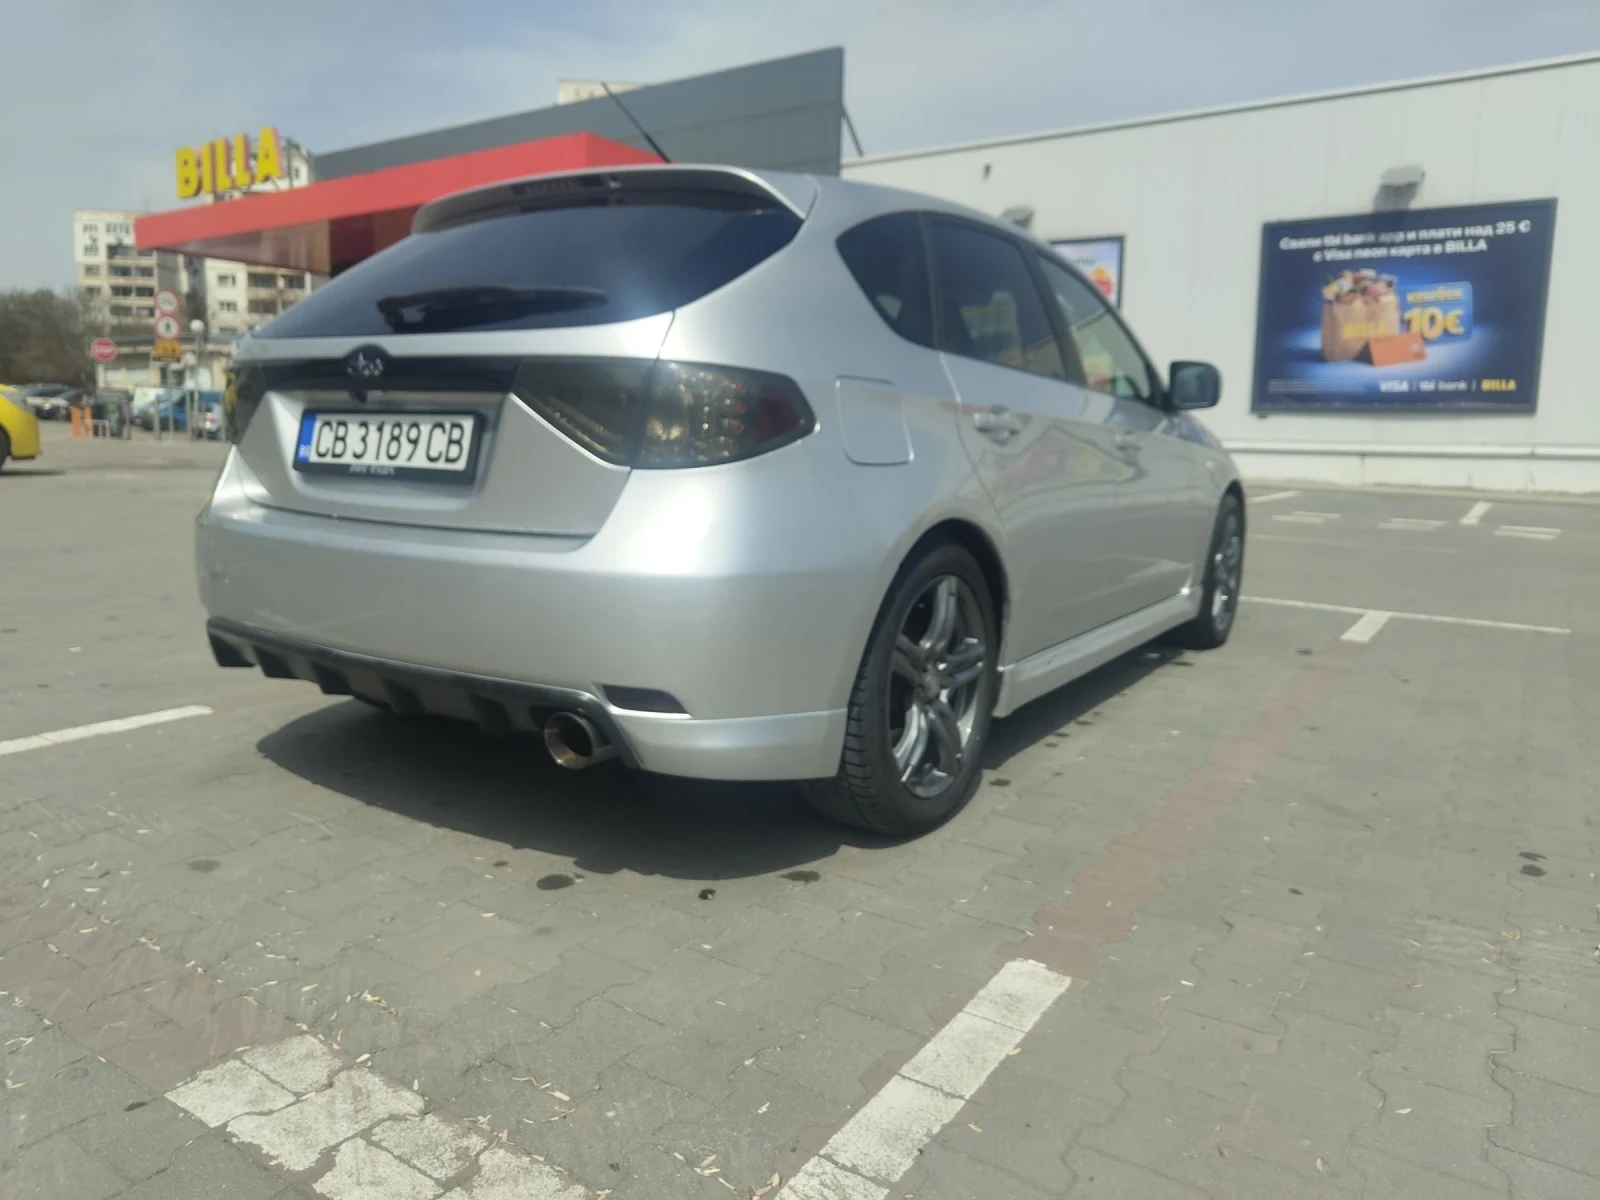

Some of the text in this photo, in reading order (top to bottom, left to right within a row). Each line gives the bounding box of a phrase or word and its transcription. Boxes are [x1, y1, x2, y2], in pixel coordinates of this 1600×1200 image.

[174, 125, 284, 200] BILLA
[1343, 231, 1375, 246] bank
[1418, 227, 1462, 240] плати
[1464, 224, 1494, 237] над
[1495, 220, 1516, 235] 25
[1324, 248, 1353, 261] Visa
[1390, 244, 1431, 258] карта
[1445, 238, 1488, 254] BILLA
[1404, 307, 1464, 340] 10€
[1481, 379, 1516, 391] BILLA
[315, 420, 465, 463] CB 3189 CB
